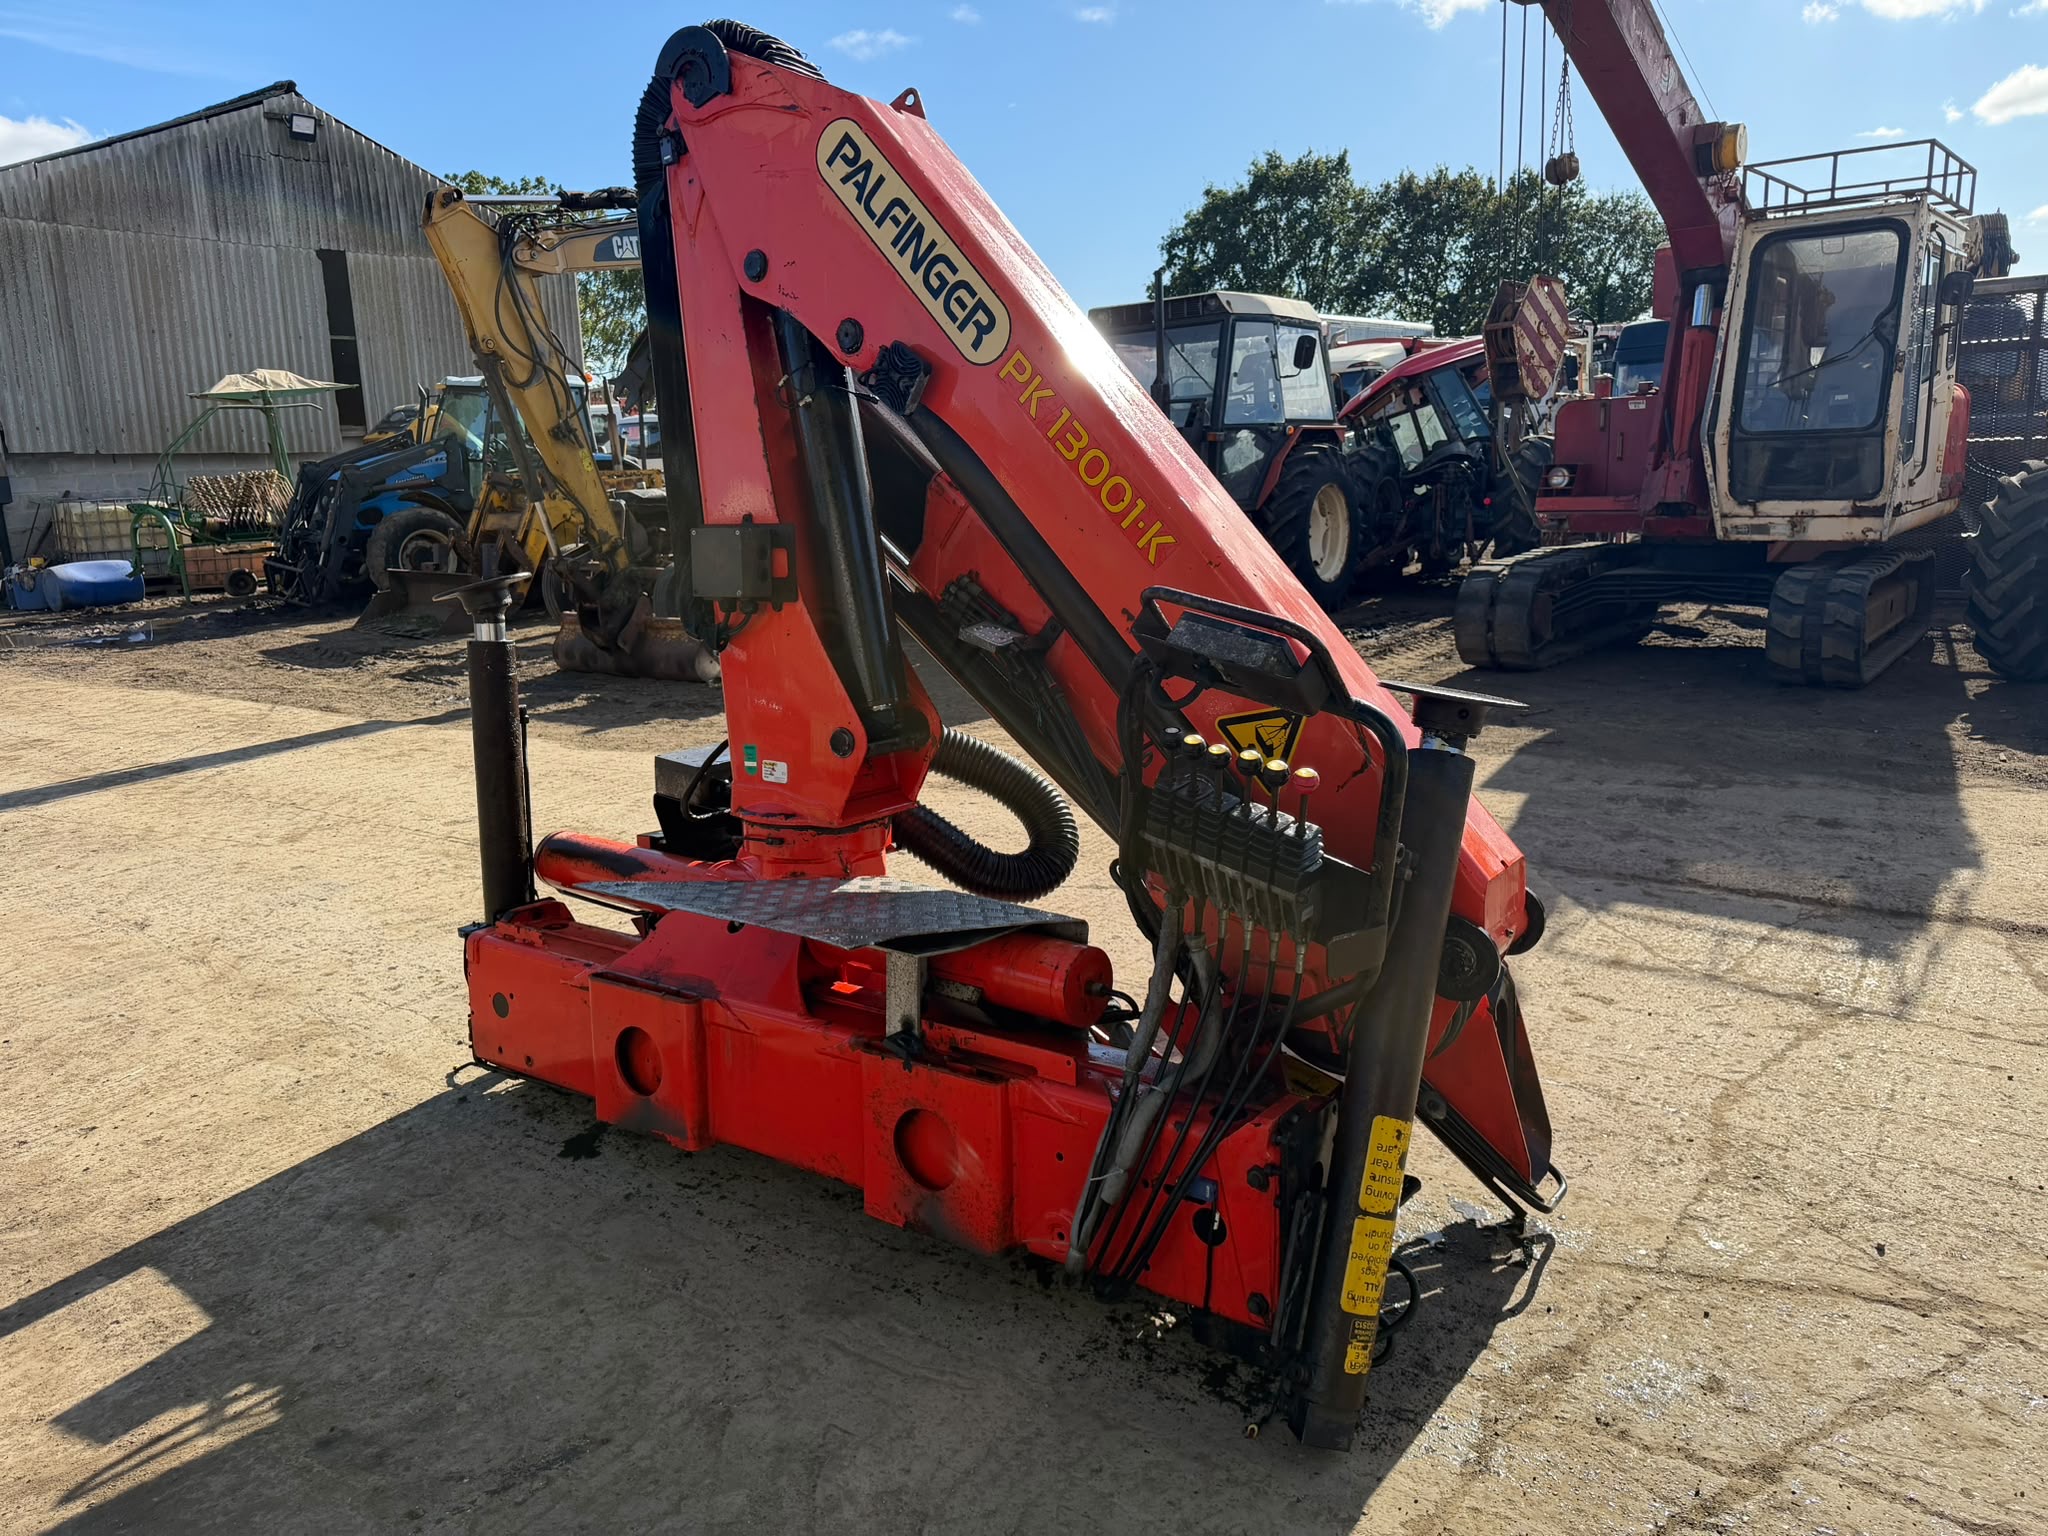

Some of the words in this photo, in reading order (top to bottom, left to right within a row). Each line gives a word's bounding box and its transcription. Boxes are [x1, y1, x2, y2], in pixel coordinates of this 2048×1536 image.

[612, 235, 640, 259] CAT
[825, 131, 996, 352] PALFINGER
[999, 352, 1055, 419] PK
[1376, 1142, 1394, 1154] are
[1370, 1157, 1393, 1169] rear
[1369, 1172, 1401, 1186] ensure
[1364, 1282, 1380, 1292] ALL
